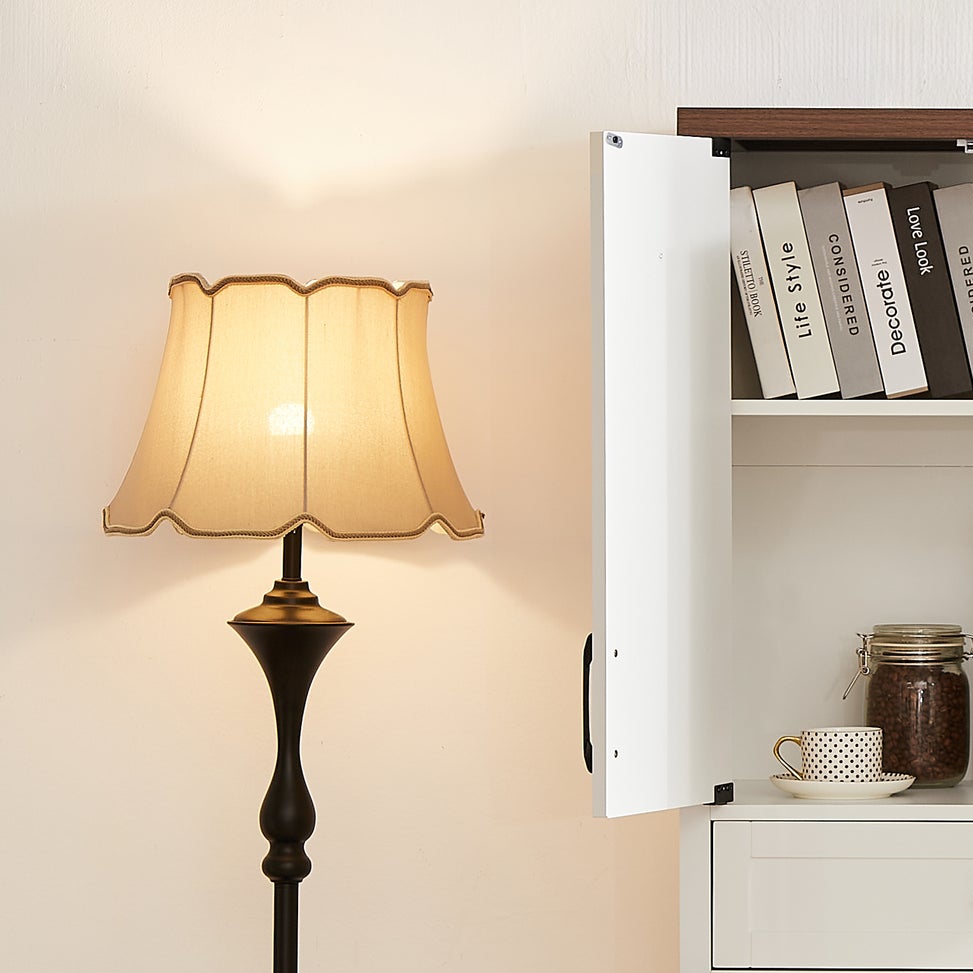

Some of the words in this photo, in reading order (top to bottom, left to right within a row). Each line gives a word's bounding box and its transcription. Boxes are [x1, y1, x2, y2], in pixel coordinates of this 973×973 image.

[907, 206, 923, 239] Love
[740, 250, 756, 290] STILETTO
[750, 293, 763, 317] BOOK
[781, 242, 803, 293] Style
[914, 241, 934, 276] Look
[828, 234, 859, 336] CONSIDERED
[794, 302, 813, 338] Life
[876, 269, 907, 356] Decorate
